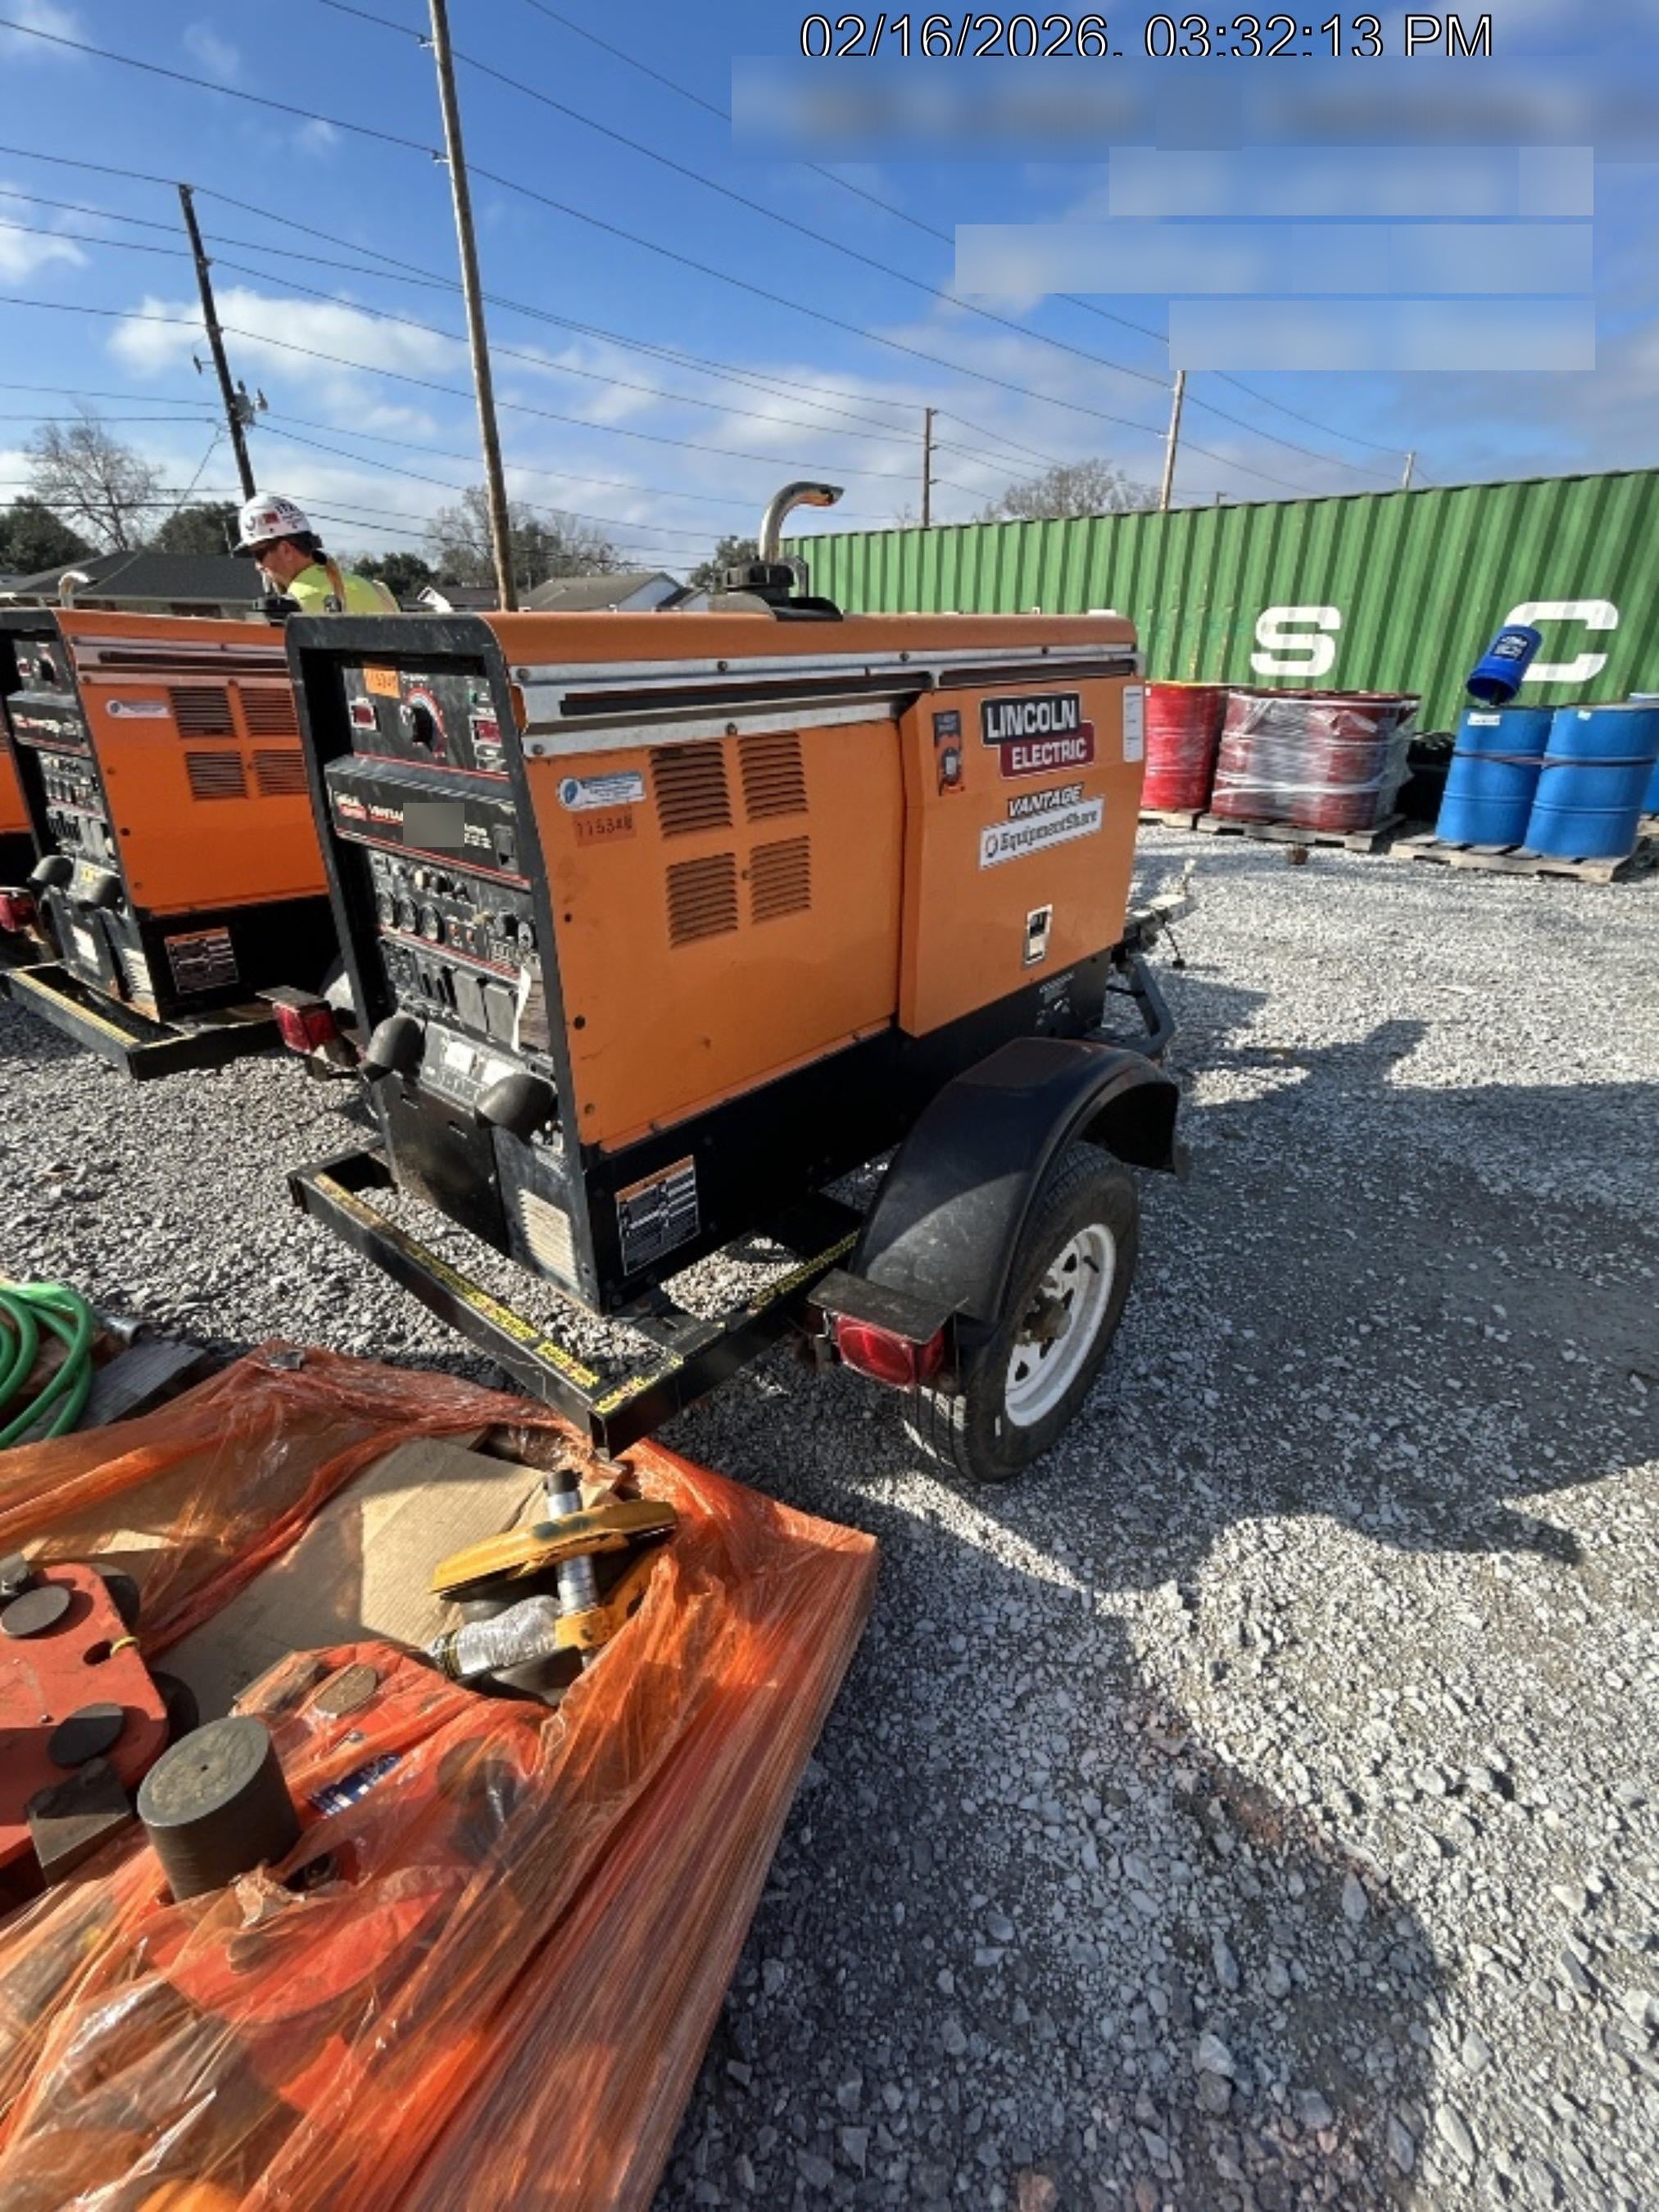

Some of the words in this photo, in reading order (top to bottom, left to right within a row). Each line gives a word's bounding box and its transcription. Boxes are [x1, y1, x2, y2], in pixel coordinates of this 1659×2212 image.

[1251, 606, 1340, 677] S
[1503, 600, 1619, 682] C
[986, 700, 1077, 738] LINCOLN
[1012, 737, 1087, 770] ELECTRIC
